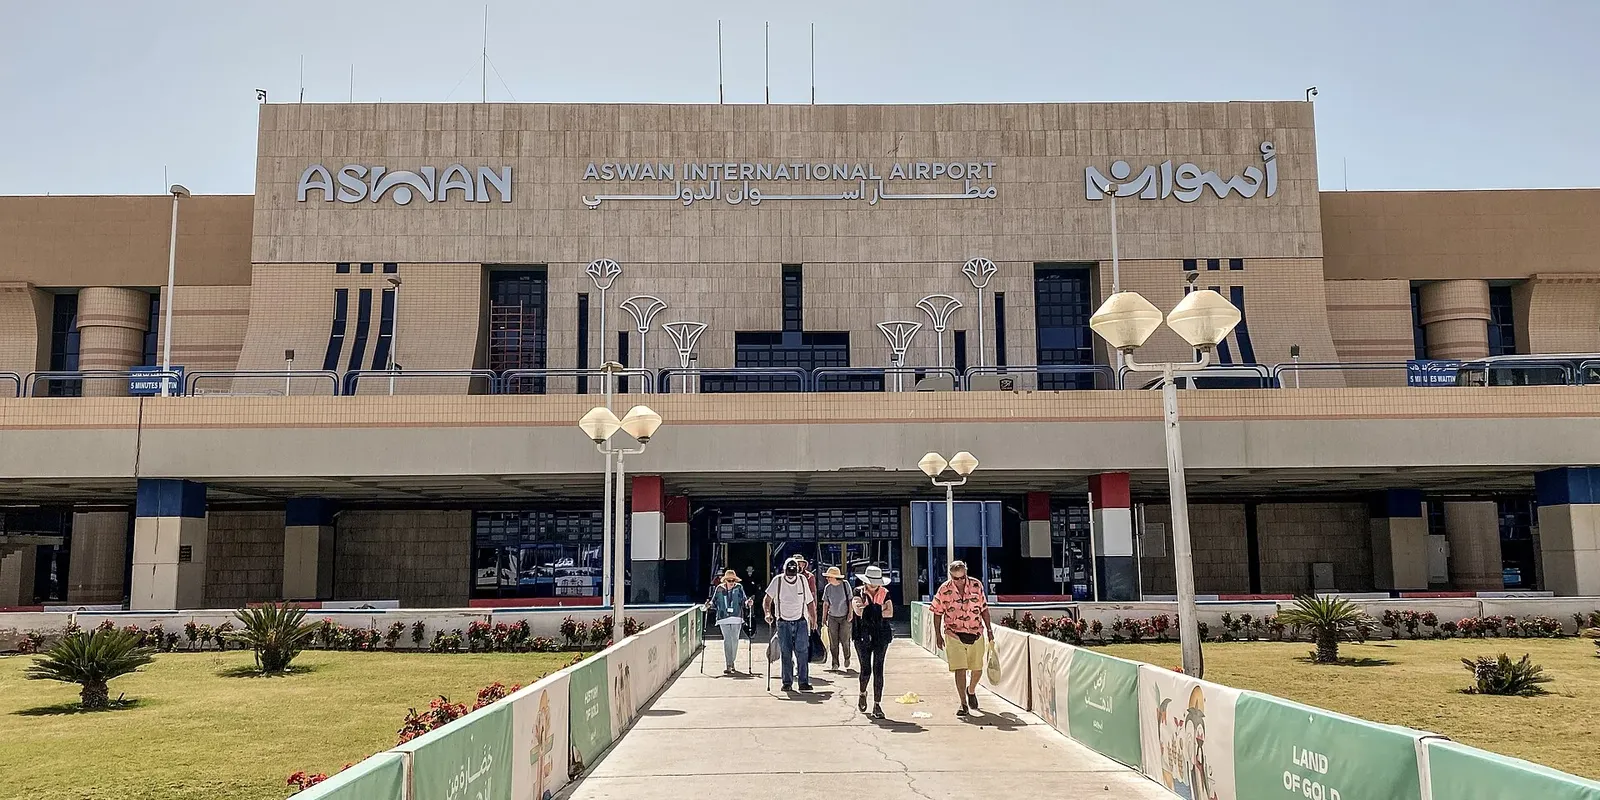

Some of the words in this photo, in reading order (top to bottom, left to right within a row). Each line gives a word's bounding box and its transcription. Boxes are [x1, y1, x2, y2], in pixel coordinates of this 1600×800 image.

[298, 163, 512, 205] ASWAN
[582, 162, 675, 180] ASWAN
[683, 162, 882, 180] INTERNATIONAL
[889, 162, 997, 180] AIRPORT
[1085, 141, 1278, 203] أسوان
[582, 180, 721, 209] الدولي
[868, 179, 998, 206] مطار
[131, 381, 135, 389] 5
[135, 381, 157, 389] MINUTES
[1437, 375, 1456, 383] WAITIN
[1292, 745, 1329, 775] LAND
[1283, 770, 1301, 793] OF
